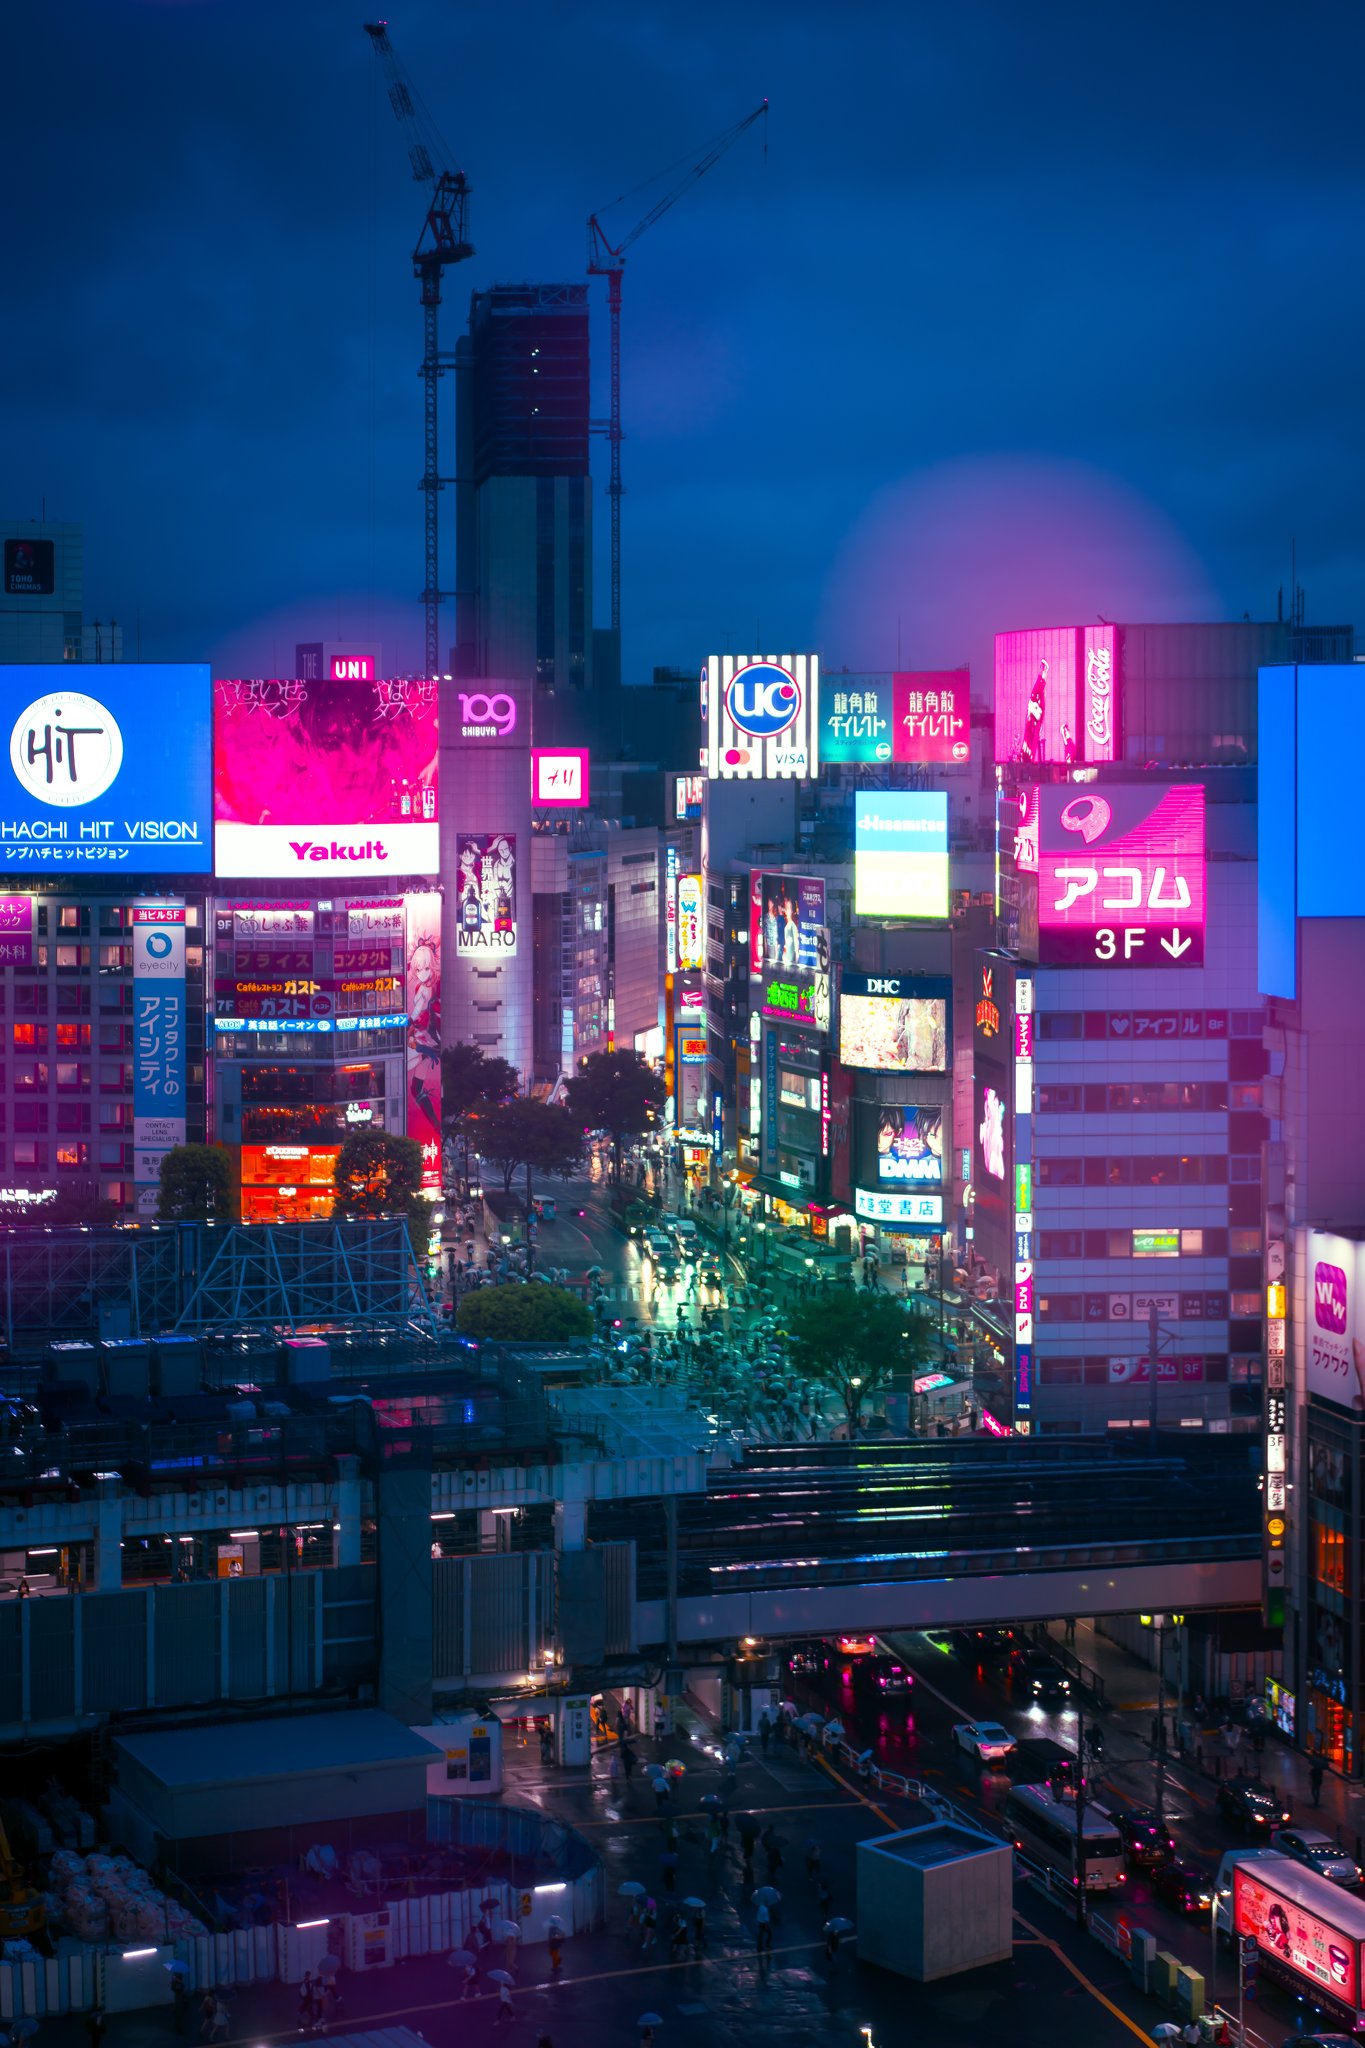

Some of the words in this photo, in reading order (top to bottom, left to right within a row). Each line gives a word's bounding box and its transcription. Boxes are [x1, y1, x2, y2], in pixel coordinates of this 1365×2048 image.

[11, 574, 33, 583] TOHO
[11, 583, 41, 591] CINEMAS
[834, 691, 878, 714] 龍角散
[909, 690, 955, 713] 龍角散
[458, 693, 516, 736] 109
[461, 726, 497, 737] SHIBUYA
[775, 753, 805, 764] VISA
[80, 821, 114, 839] HIT
[124, 821, 198, 839] VISION
[289, 841, 389, 861] Yakult
[1054, 867, 1192, 911] アコム
[0, 916, 21, 926] ック
[138, 909, 180, 921] 当ビル5F
[366, 914, 402, 930] しゃぶ葉
[217, 920, 232, 930] 9F
[261, 917, 309, 932] しゃぶ葉
[458, 931, 515, 947] MARO
[1094, 929, 1147, 961] 3F
[139, 960, 179, 973] eyecity
[334, 951, 389, 968] コンタクト
[284, 980, 321, 995] ガスト
[375, 977, 401, 991] ガスト
[867, 978, 899, 994] DHC
[217, 1000, 234, 1011] 7F
[261, 997, 306, 1015] ガスト
[248, 1019, 316, 1031] 英会話イーオン
[358, 1016, 408, 1029] 英会話イーオン
[1134, 1018, 1199, 1034] アイフル
[139, 996, 160, 1095] アイシティ
[164, 996, 179, 1096] コンタクトの
[1019, 1024, 1029, 1056] アイフル
[879, 1158, 941, 1179] DMM
[1136, 1298, 1175, 1307] EAST
[1184, 1363, 1200, 1375] 3F
[1312, 1349, 1349, 1377] ワクワク
[1269, 1436, 1283, 1446] 3F
